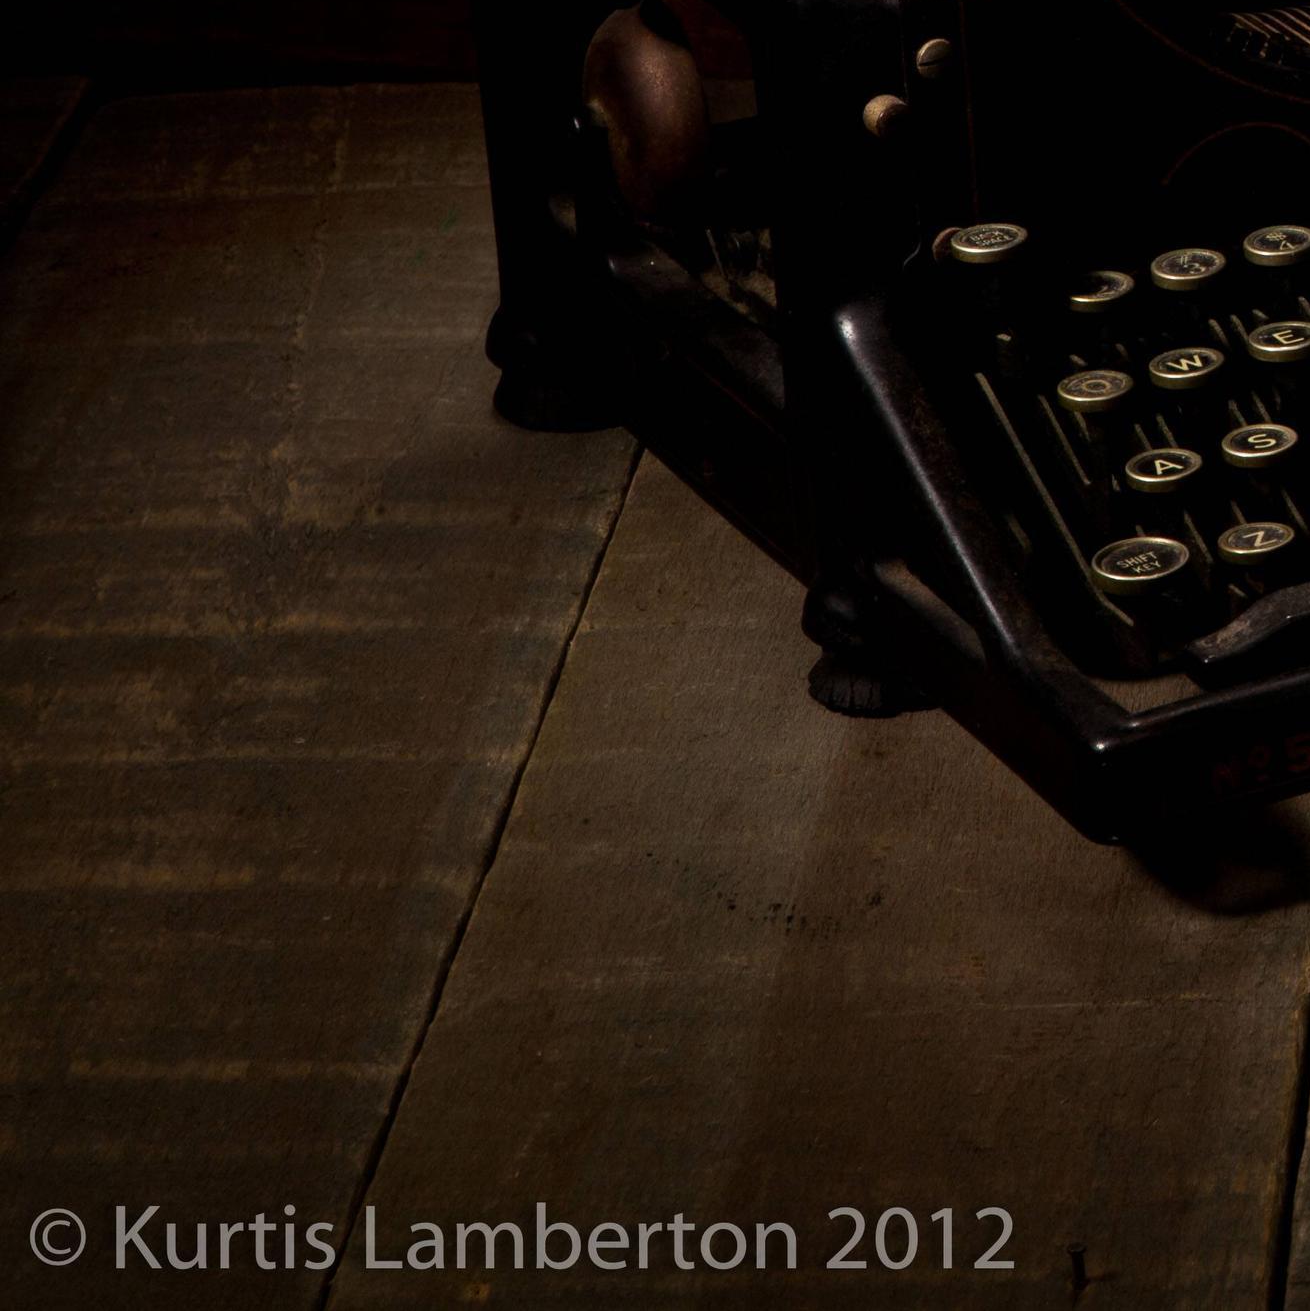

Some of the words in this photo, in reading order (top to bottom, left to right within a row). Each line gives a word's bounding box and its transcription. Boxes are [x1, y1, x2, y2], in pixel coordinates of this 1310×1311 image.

[1274, 329, 1305, 345] E
[1166, 353, 1204, 372] W
[1248, 432, 1279, 450] S
[1153, 458, 1185, 475] A
[1246, 531, 1278, 549] Z
[1115, 551, 1158, 573] SHIFT
[1132, 561, 1162, 578] KEY
